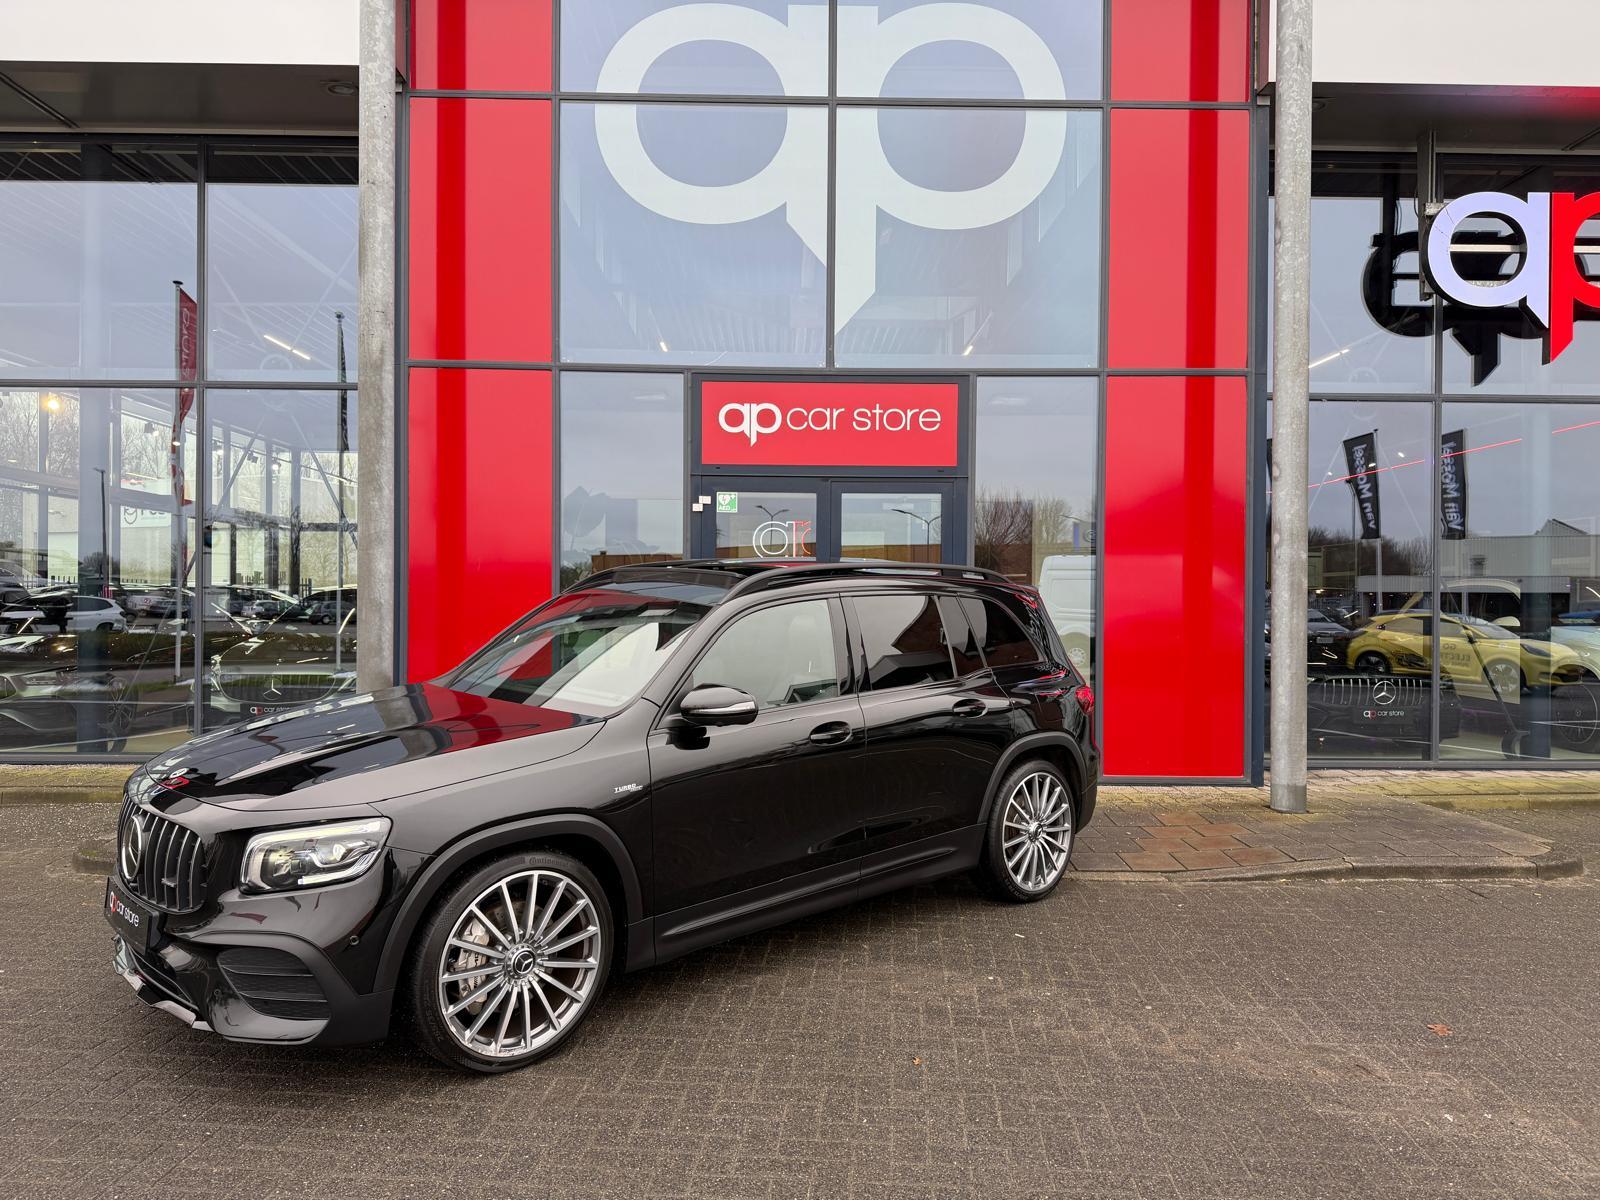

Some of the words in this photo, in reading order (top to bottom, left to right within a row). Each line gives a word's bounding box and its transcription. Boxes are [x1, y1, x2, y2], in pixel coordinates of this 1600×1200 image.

[595, 2, 1067, 336] ap
[718, 402, 782, 447] ap
[786, 407, 845, 430] car
[852, 403, 941, 431] store
